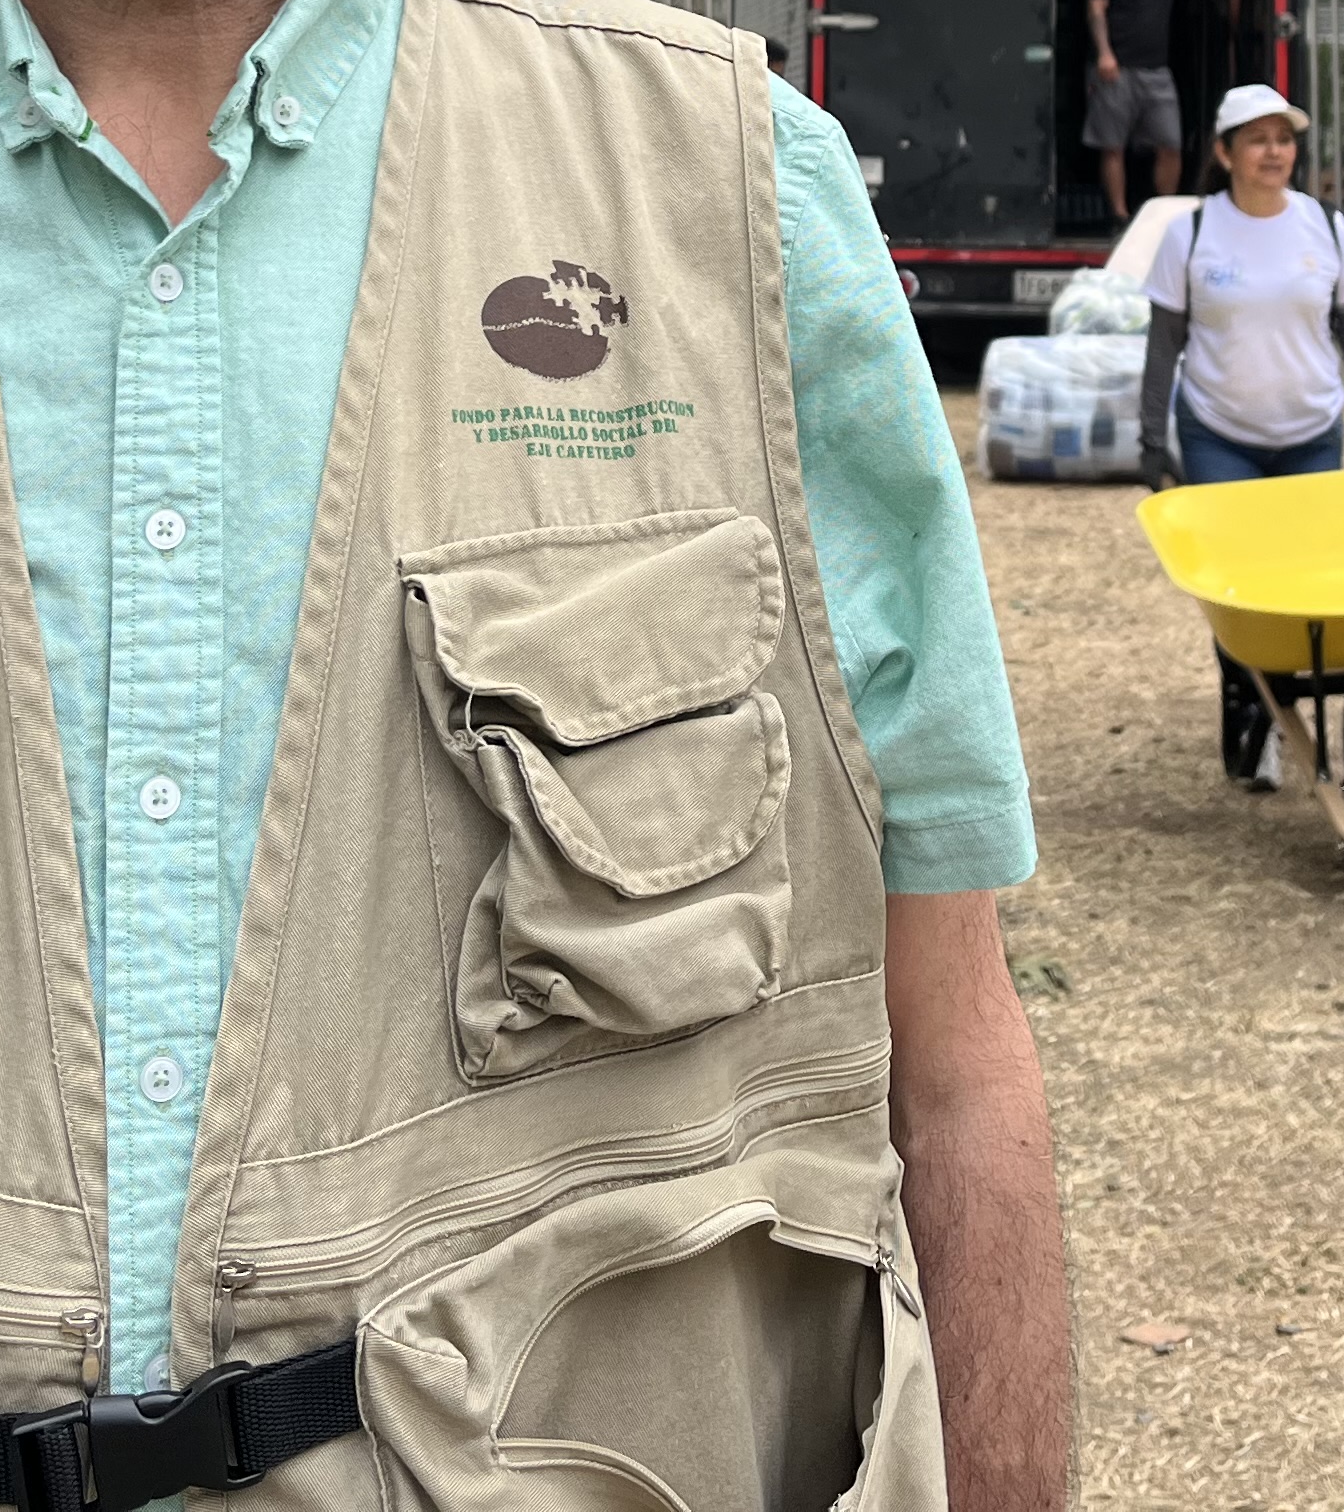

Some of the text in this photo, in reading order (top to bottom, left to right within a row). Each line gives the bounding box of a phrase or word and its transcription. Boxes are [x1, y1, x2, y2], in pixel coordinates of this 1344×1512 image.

[452, 399, 694, 424] FONDO PARA LA RECONSTRUCCION
[473, 418, 679, 443] Y DESARROLLO SOCIAL DEL
[556, 443, 636, 460] CAFETERO
